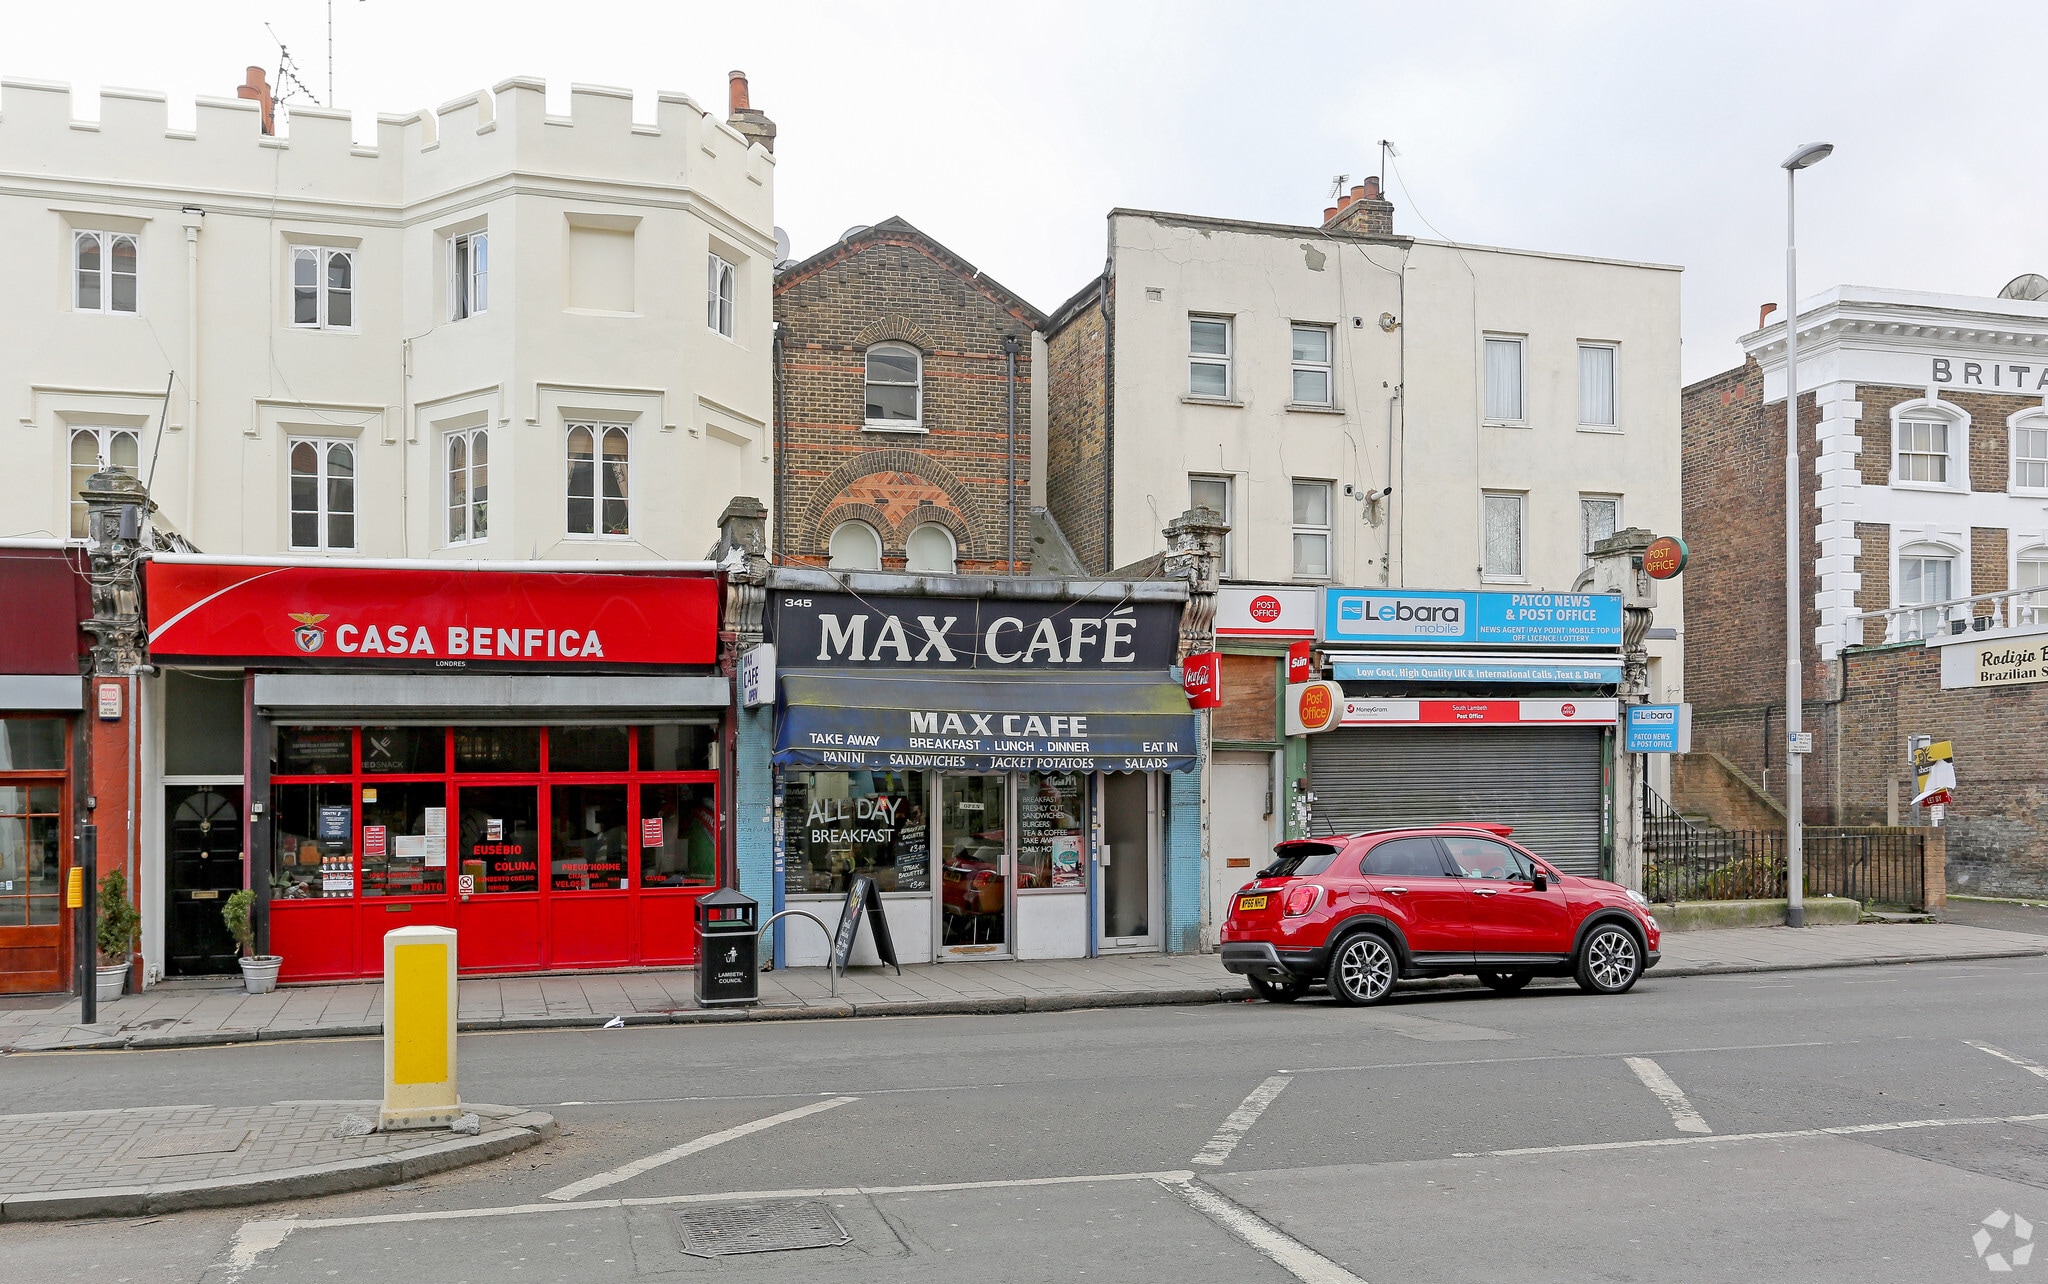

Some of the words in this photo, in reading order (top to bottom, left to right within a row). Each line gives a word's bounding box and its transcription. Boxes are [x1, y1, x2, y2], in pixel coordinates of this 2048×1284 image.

[1650, 548, 1670, 560] POST
[1646, 560, 1674, 572] OFFICE
[784, 598, 812, 608] 345
[1512, 594, 1551, 606] PATCO
[1554, 596, 1590, 607] NEWS
[1366, 600, 1458, 622] Lebara
[1506, 609, 1516, 620] &
[1520, 609, 1554, 620] POST
[1556, 610, 1596, 621] OFFICE
[816, 614, 957, 662] MAX
[984, 606, 1137, 664] CAFÉ
[1414, 624, 1458, 634] mobile
[336, 624, 435, 654] CASA
[448, 626, 604, 657] BENFICA
[1291, 656, 1307, 668] Sun
[1981, 650, 2036, 667] Rodizio
[744, 666, 758, 688] CAFE
[1357, 668, 1374, 676] Low
[1376, 668, 1398, 678] Cost,
[1400, 668, 1419, 679] High
[1422, 668, 1451, 680] Quality
[1454, 669, 1466, 678] UK
[1468, 670, 1474, 678] &
[1476, 670, 1530, 679] International
[1532, 670, 1552, 679] Calls
[1584, 671, 1602, 680] Data
[1980, 669, 2036, 681] Brazilian
[101, 690, 116, 699] BMD
[1306, 691, 1323, 704] Post
[1302, 707, 1327, 720] Office
[910, 712, 993, 736] MAX
[1003, 715, 1088, 738] CAFE
[809, 733, 843, 745] TAKE
[846, 734, 880, 747] AWAY
[910, 738, 980, 750] BREAKFAST
[995, 741, 1034, 751] LUNCH
[1048, 742, 1089, 752] DINNER
[1143, 742, 1164, 752] EAT
[1167, 743, 1178, 752] IN
[823, 751, 865, 763] PANINI
[890, 754, 965, 766] SANDWICHES
[991, 756, 1036, 768] JACKET
[1037, 757, 1094, 768] POTATOES
[1125, 758, 1168, 768] SALADS
[806, 798, 850, 827] ALL
[857, 798, 902, 826] DAY
[812, 829, 895, 843] BREAKFAST
[473, 843, 522, 855] EUSÉBIO
[495, 862, 536, 871] COLUNA
[562, 863, 620, 871] PREUD'HOMME
[411, 883, 443, 891] BENTO
